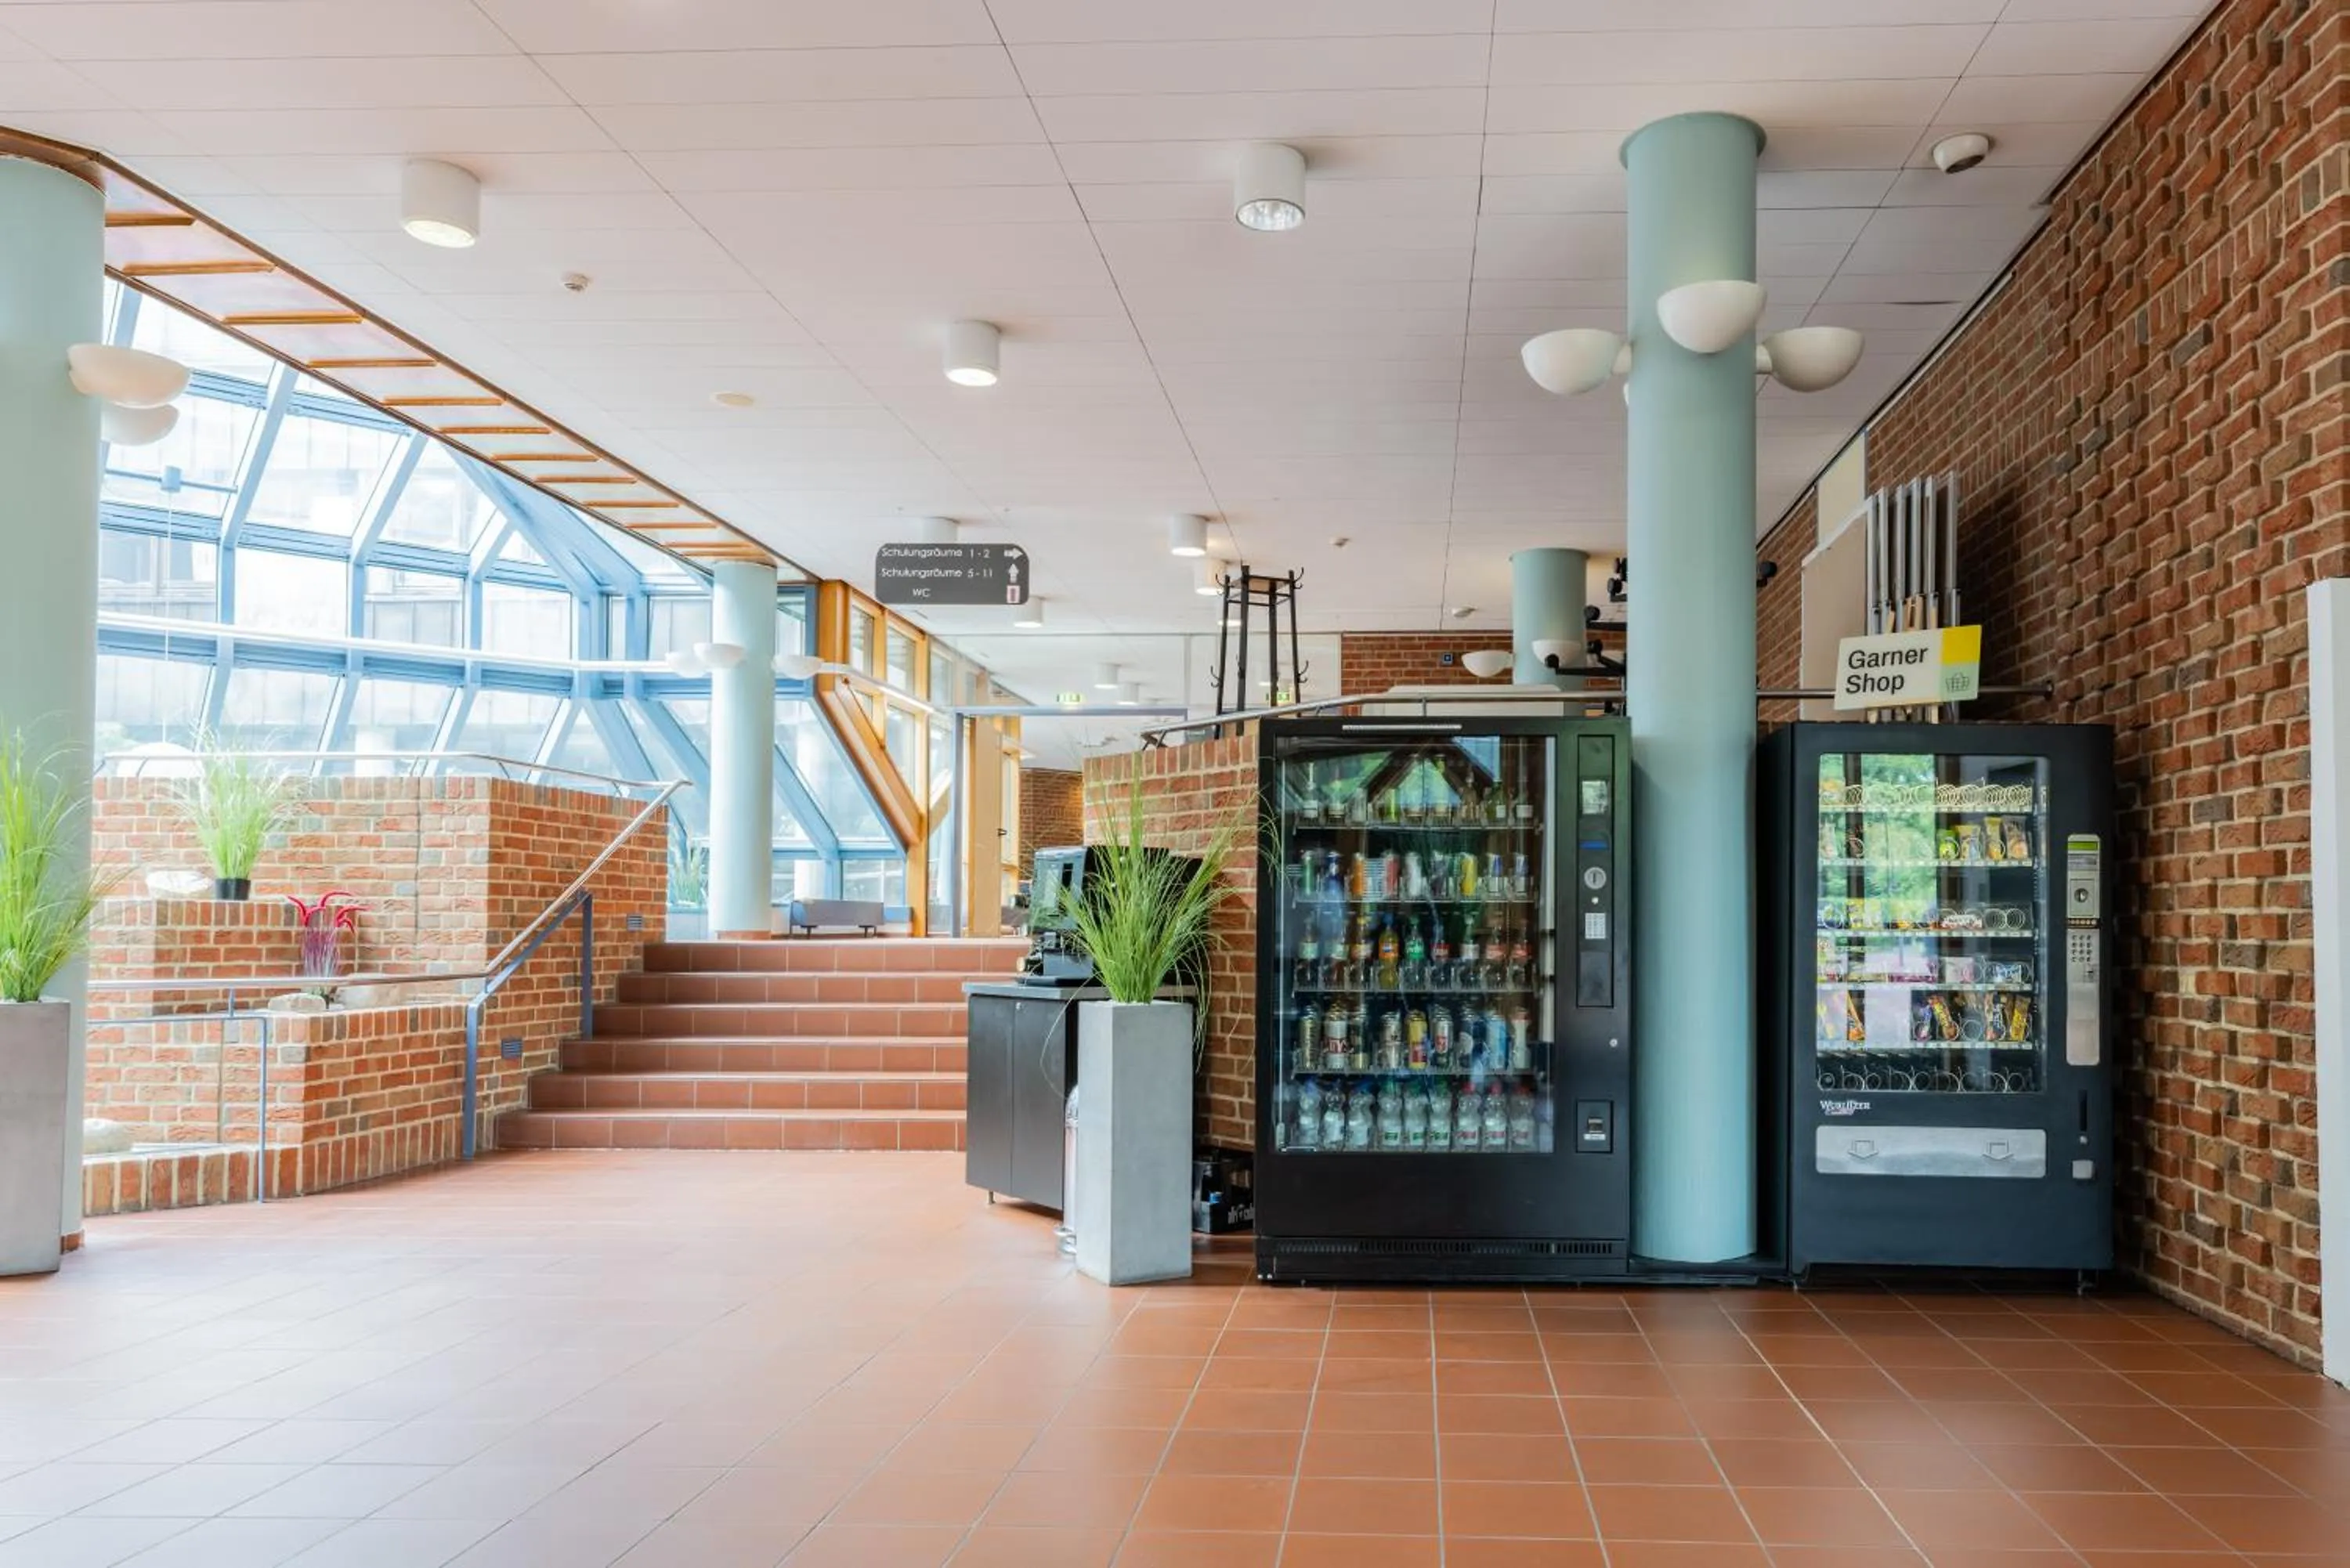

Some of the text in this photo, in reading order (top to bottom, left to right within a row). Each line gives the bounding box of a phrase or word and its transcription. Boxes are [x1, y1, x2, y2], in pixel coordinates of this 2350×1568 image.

[881, 547, 963, 558] Schulungsräume
[984, 549, 990, 558] 2
[881, 567, 963, 579] Schulungsräume
[967, 569, 974, 578] 5
[983, 569, 992, 578] 11
[913, 588, 931, 598] WC
[1848, 647, 1928, 670] Garner
[1846, 673, 1904, 695] Shop
